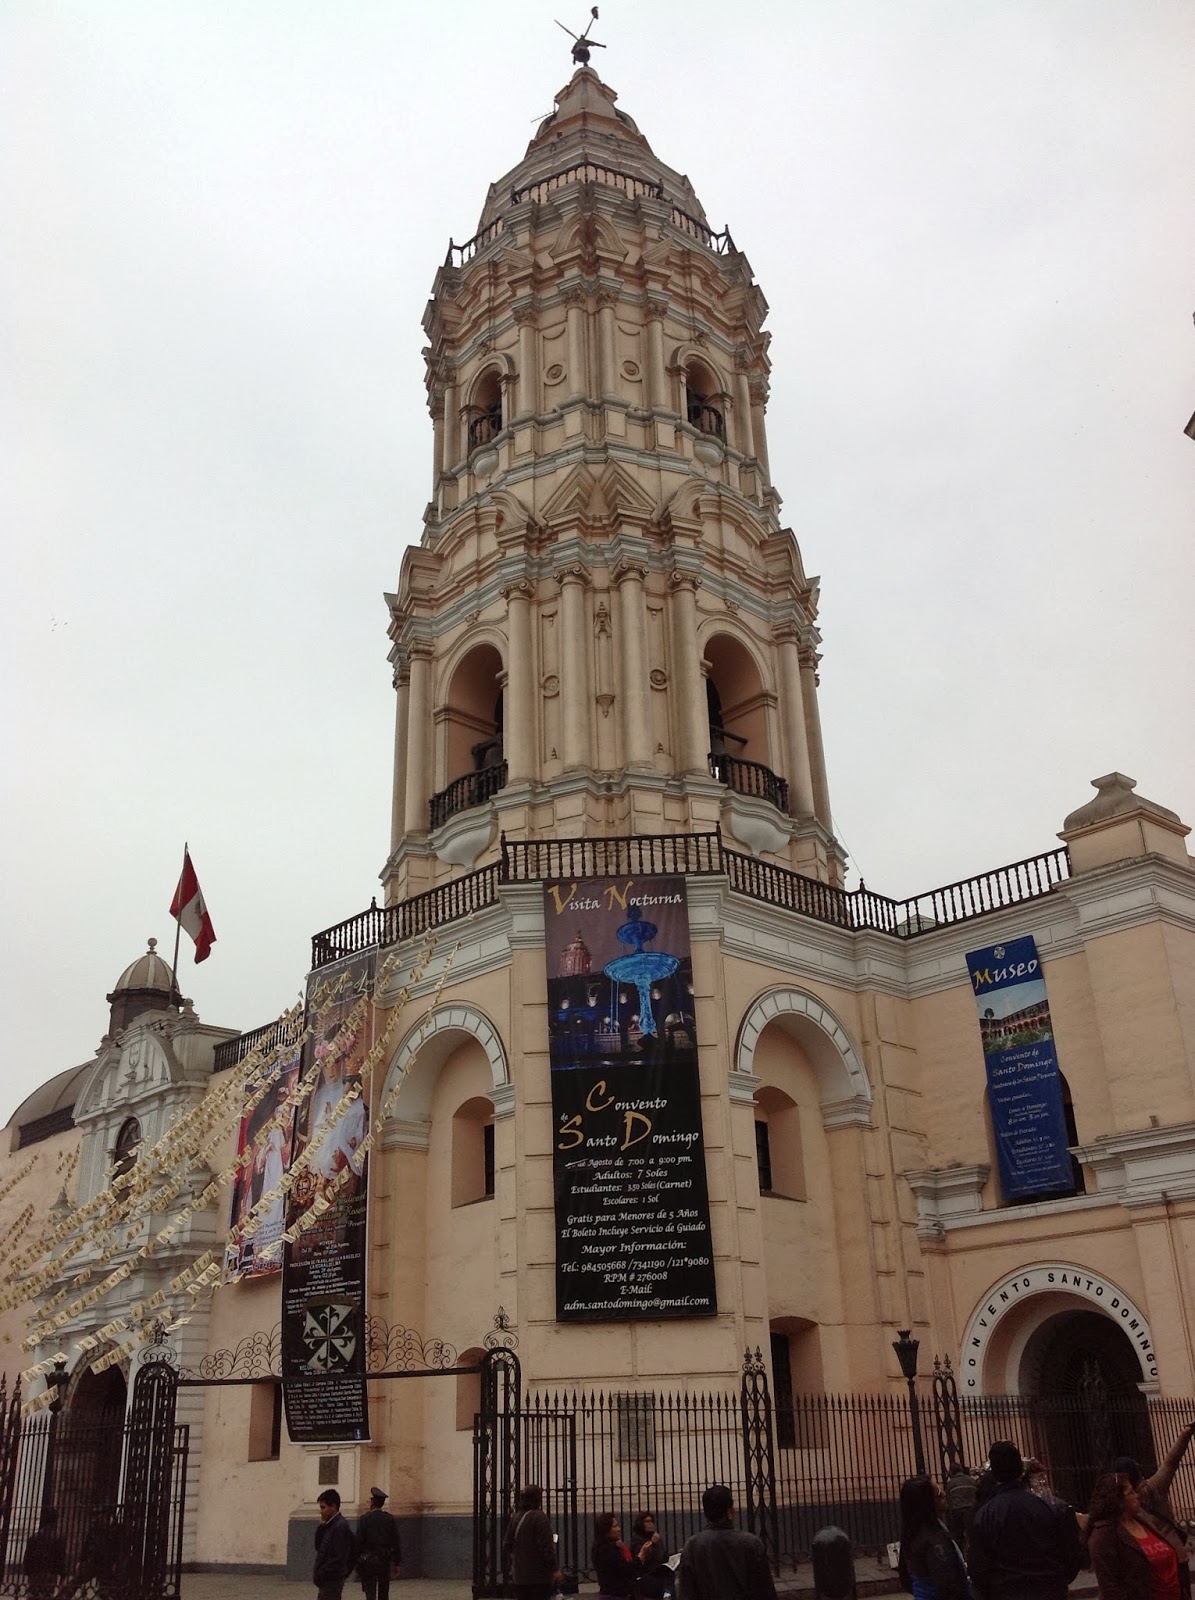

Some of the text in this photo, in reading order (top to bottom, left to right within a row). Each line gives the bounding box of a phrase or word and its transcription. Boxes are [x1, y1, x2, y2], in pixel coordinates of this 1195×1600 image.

[548, 881, 683, 915] Visita Nocturna
[973, 958, 1038, 988] Museo
[1000, 1051, 1031, 1063] Convento
[992, 1059, 1052, 1077] Santo Domingo
[586, 1080, 667, 1111] Convento
[560, 1113, 569, 1122] de
[558, 1111, 699, 1151] Santo Domingo
[588, 1159, 612, 1168] Agosto
[614, 1157, 624, 1166] de
[659, 1157, 675, 1166] 9:00
[675, 1156, 692, 1165] pm.
[592, 1168, 668, 1180] Adultos: 7 Soles
[571, 1183, 622, 1194] Estudiantes:
[641, 1181, 656, 1190] Soles
[656, 1179, 692, 1191] (Carnet)
[603, 1196, 638, 1206] Escolares:
[647, 1194, 661, 1203] Sol
[567, 1209, 698, 1225] Gratis para Menores de 5 Años
[561, 1221, 706, 1238] El Boleto Incluye Servicio de Guiado
[581, 1241, 687, 1256] Mayor Información:
[581, 1260, 627, 1272] 984505668
[603, 1271, 668, 1283] RPM # 276008
[620, 1283, 652, 1295] E-Mail:
[564, 1295, 709, 1310] adm.santodomingo@gmail.com
[967, 1273, 1158, 1387] CONVENTO SANTO DOMINGO
